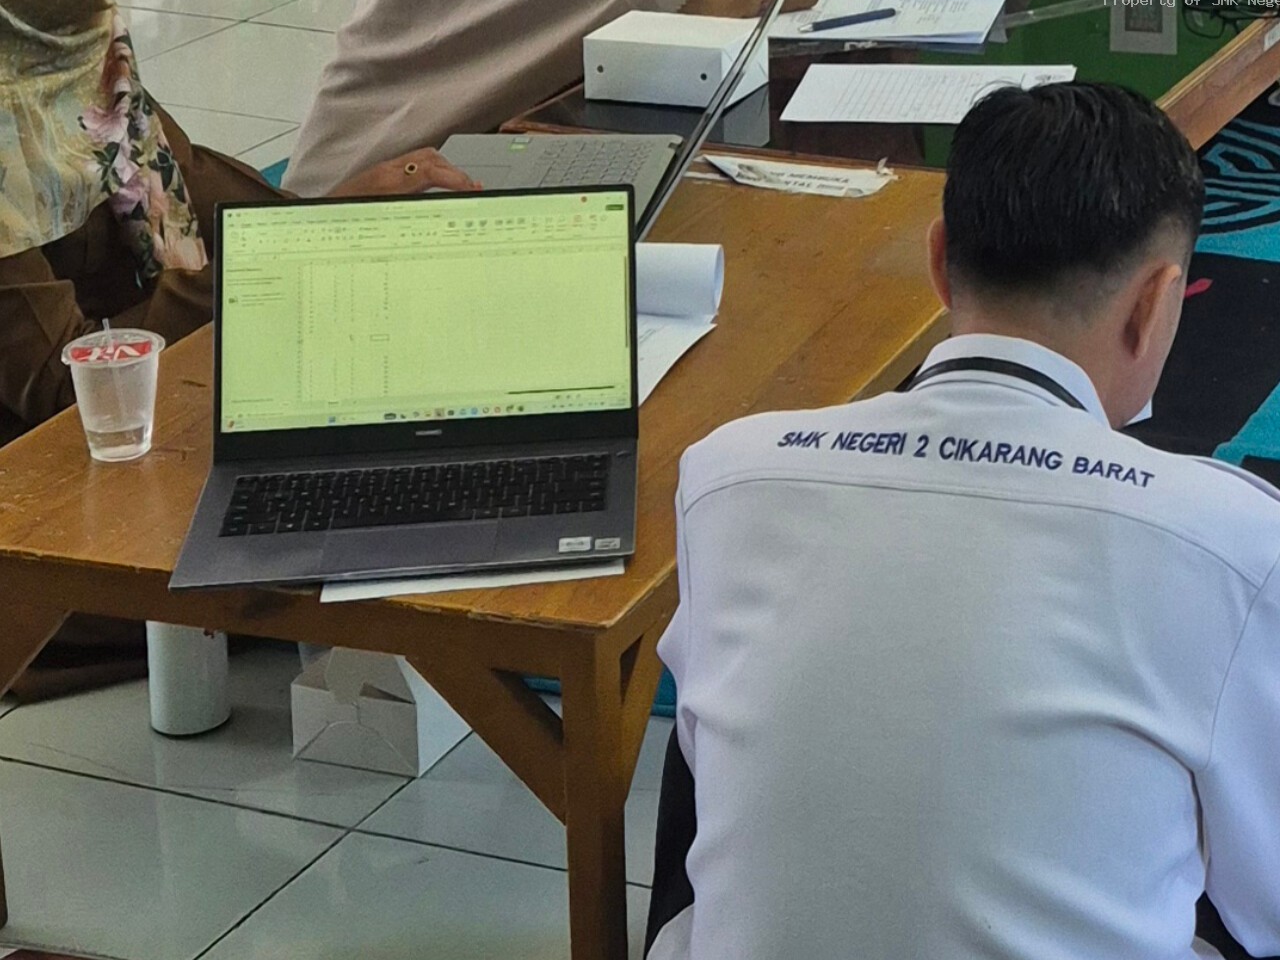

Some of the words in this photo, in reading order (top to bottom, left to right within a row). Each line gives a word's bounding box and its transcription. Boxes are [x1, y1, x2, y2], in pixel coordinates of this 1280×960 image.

[777, 431, 829, 449] SMK
[830, 431, 908, 455] NEGERI
[913, 434, 930, 458] 2
[938, 436, 1063, 470] CIKARANG
[1071, 455, 1155, 488] BARAT
